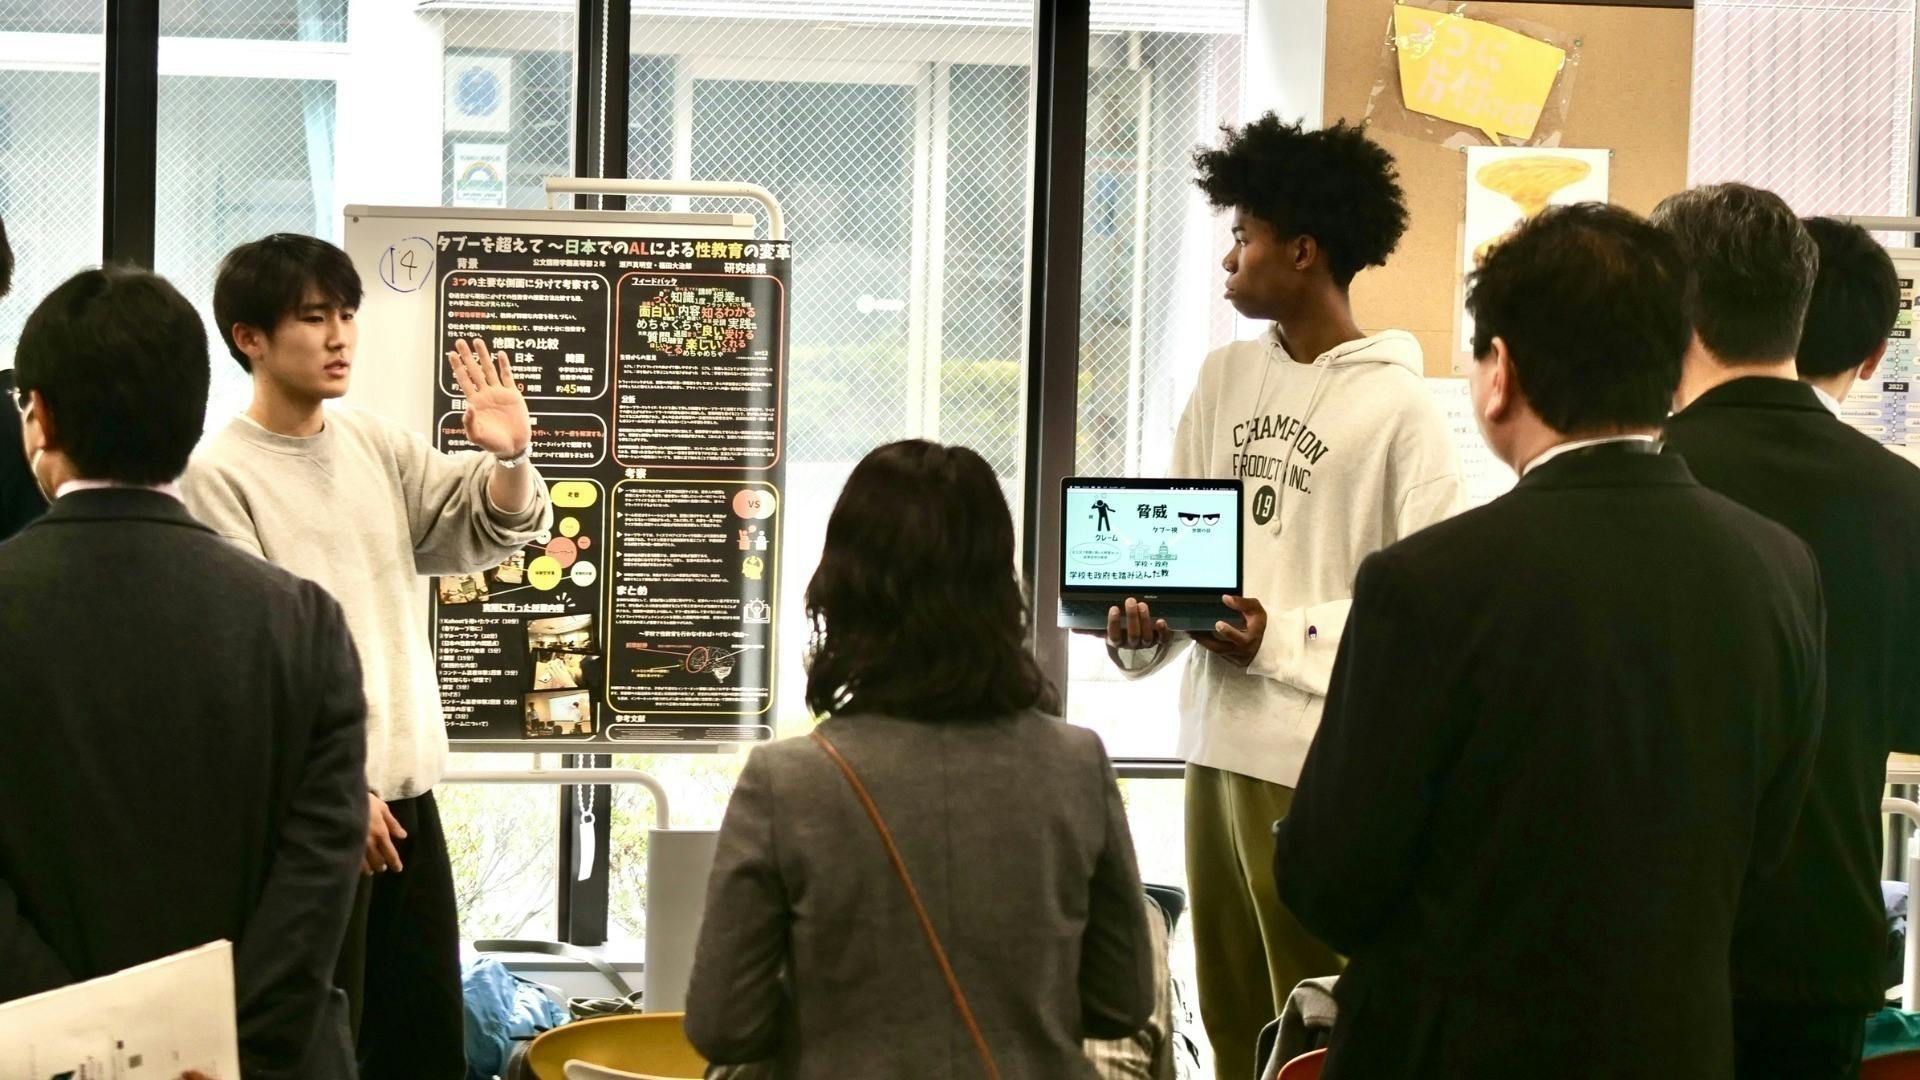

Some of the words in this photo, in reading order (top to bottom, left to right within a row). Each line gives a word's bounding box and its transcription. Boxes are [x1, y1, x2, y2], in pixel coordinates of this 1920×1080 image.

[437, 236, 544, 254] タブーを超えて
[390, 247, 418, 284] 14
[458, 258, 478, 270] 背景
[724, 262, 767, 274] 研究結果
[452, 278, 600, 291] 3つの主要な側面に分けて考察する
[632, 278, 678, 286] フィードバック
[654, 296, 668, 304] つく
[670, 291, 695, 304] 知識
[713, 291, 735, 303] 授業
[639, 305, 674, 318] 面白い
[678, 304, 700, 317] 内容
[701, 307, 724, 319] 知る
[724, 307, 756, 318] わかる
[636, 319, 702, 330] めちゃくちゃ
[728, 318, 752, 329] 実践
[702, 324, 724, 337] 良い
[724, 329, 754, 340] 受ける
[492, 337, 559, 350] 他国との比較
[647, 331, 671, 344] 質問
[664, 345, 683, 354] とる
[686, 338, 721, 350] 楽しい
[722, 340, 746, 348] くれる
[515, 353, 534, 363] 日本
[556, 384, 591, 394] 約45時間
[1233, 414, 1329, 466] CHAMPION
[625, 468, 647, 479] 考察
[1233, 454, 1289, 484] PRODUCT
[1288, 464, 1312, 494] INC.
[748, 500, 760, 508] VS
[1256, 493, 1273, 518] 19
[1137, 503, 1168, 519] 脅威
[616, 586, 648, 596] まとめ
